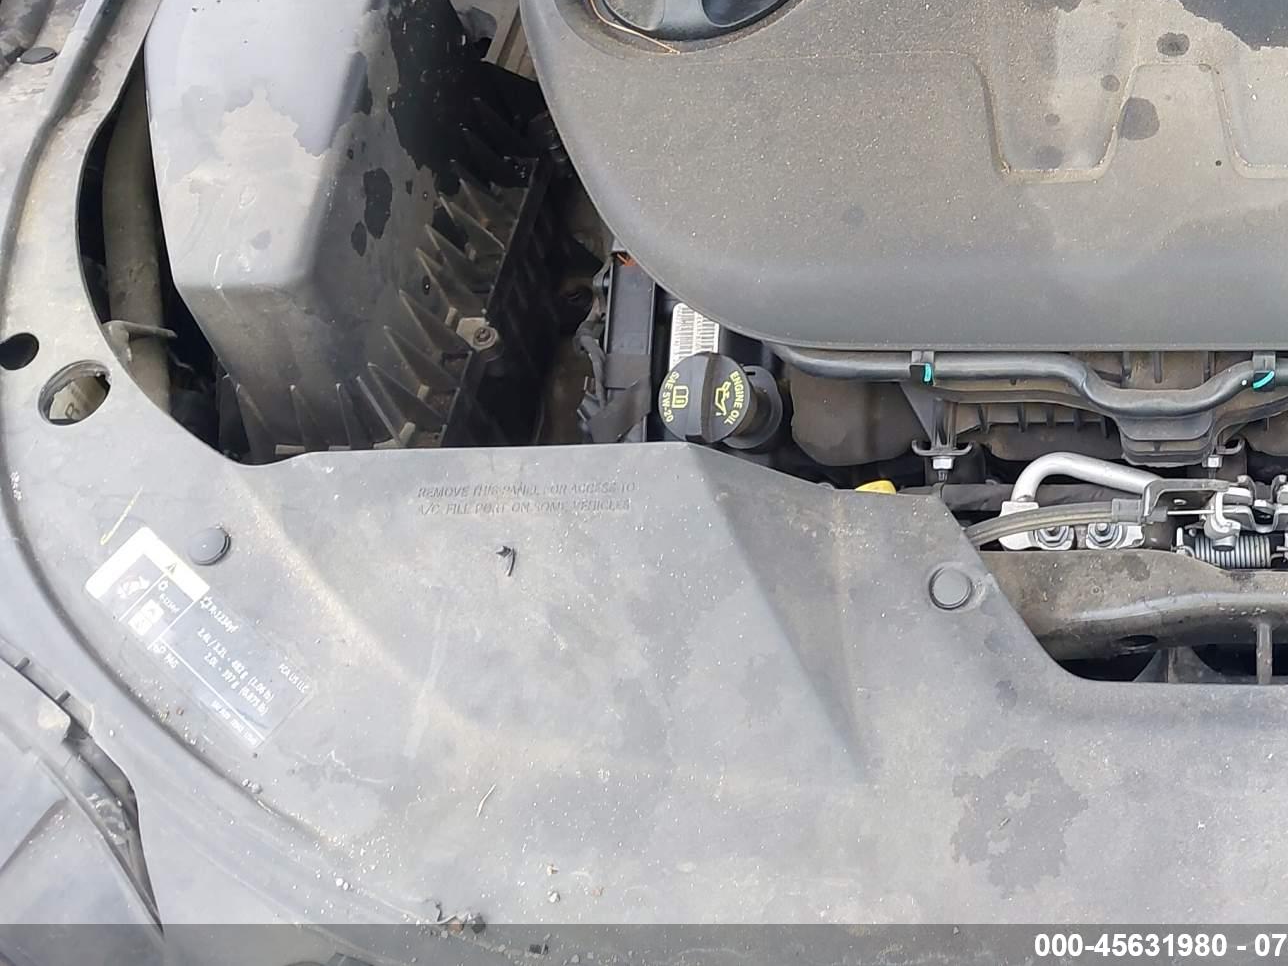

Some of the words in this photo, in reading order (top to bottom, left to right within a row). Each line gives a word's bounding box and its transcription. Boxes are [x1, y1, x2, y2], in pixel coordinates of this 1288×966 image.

[663, 371, 681, 392] SAE
[729, 370, 746, 409] ENGINE
[661, 392, 675, 423] 5W-20
[723, 410, 741, 426] OIL
[417, 487, 469, 499] REMOVE
[446, 502, 471, 515] FILL
[473, 501, 507, 515] PORT
[511, 501, 531, 514] ON
